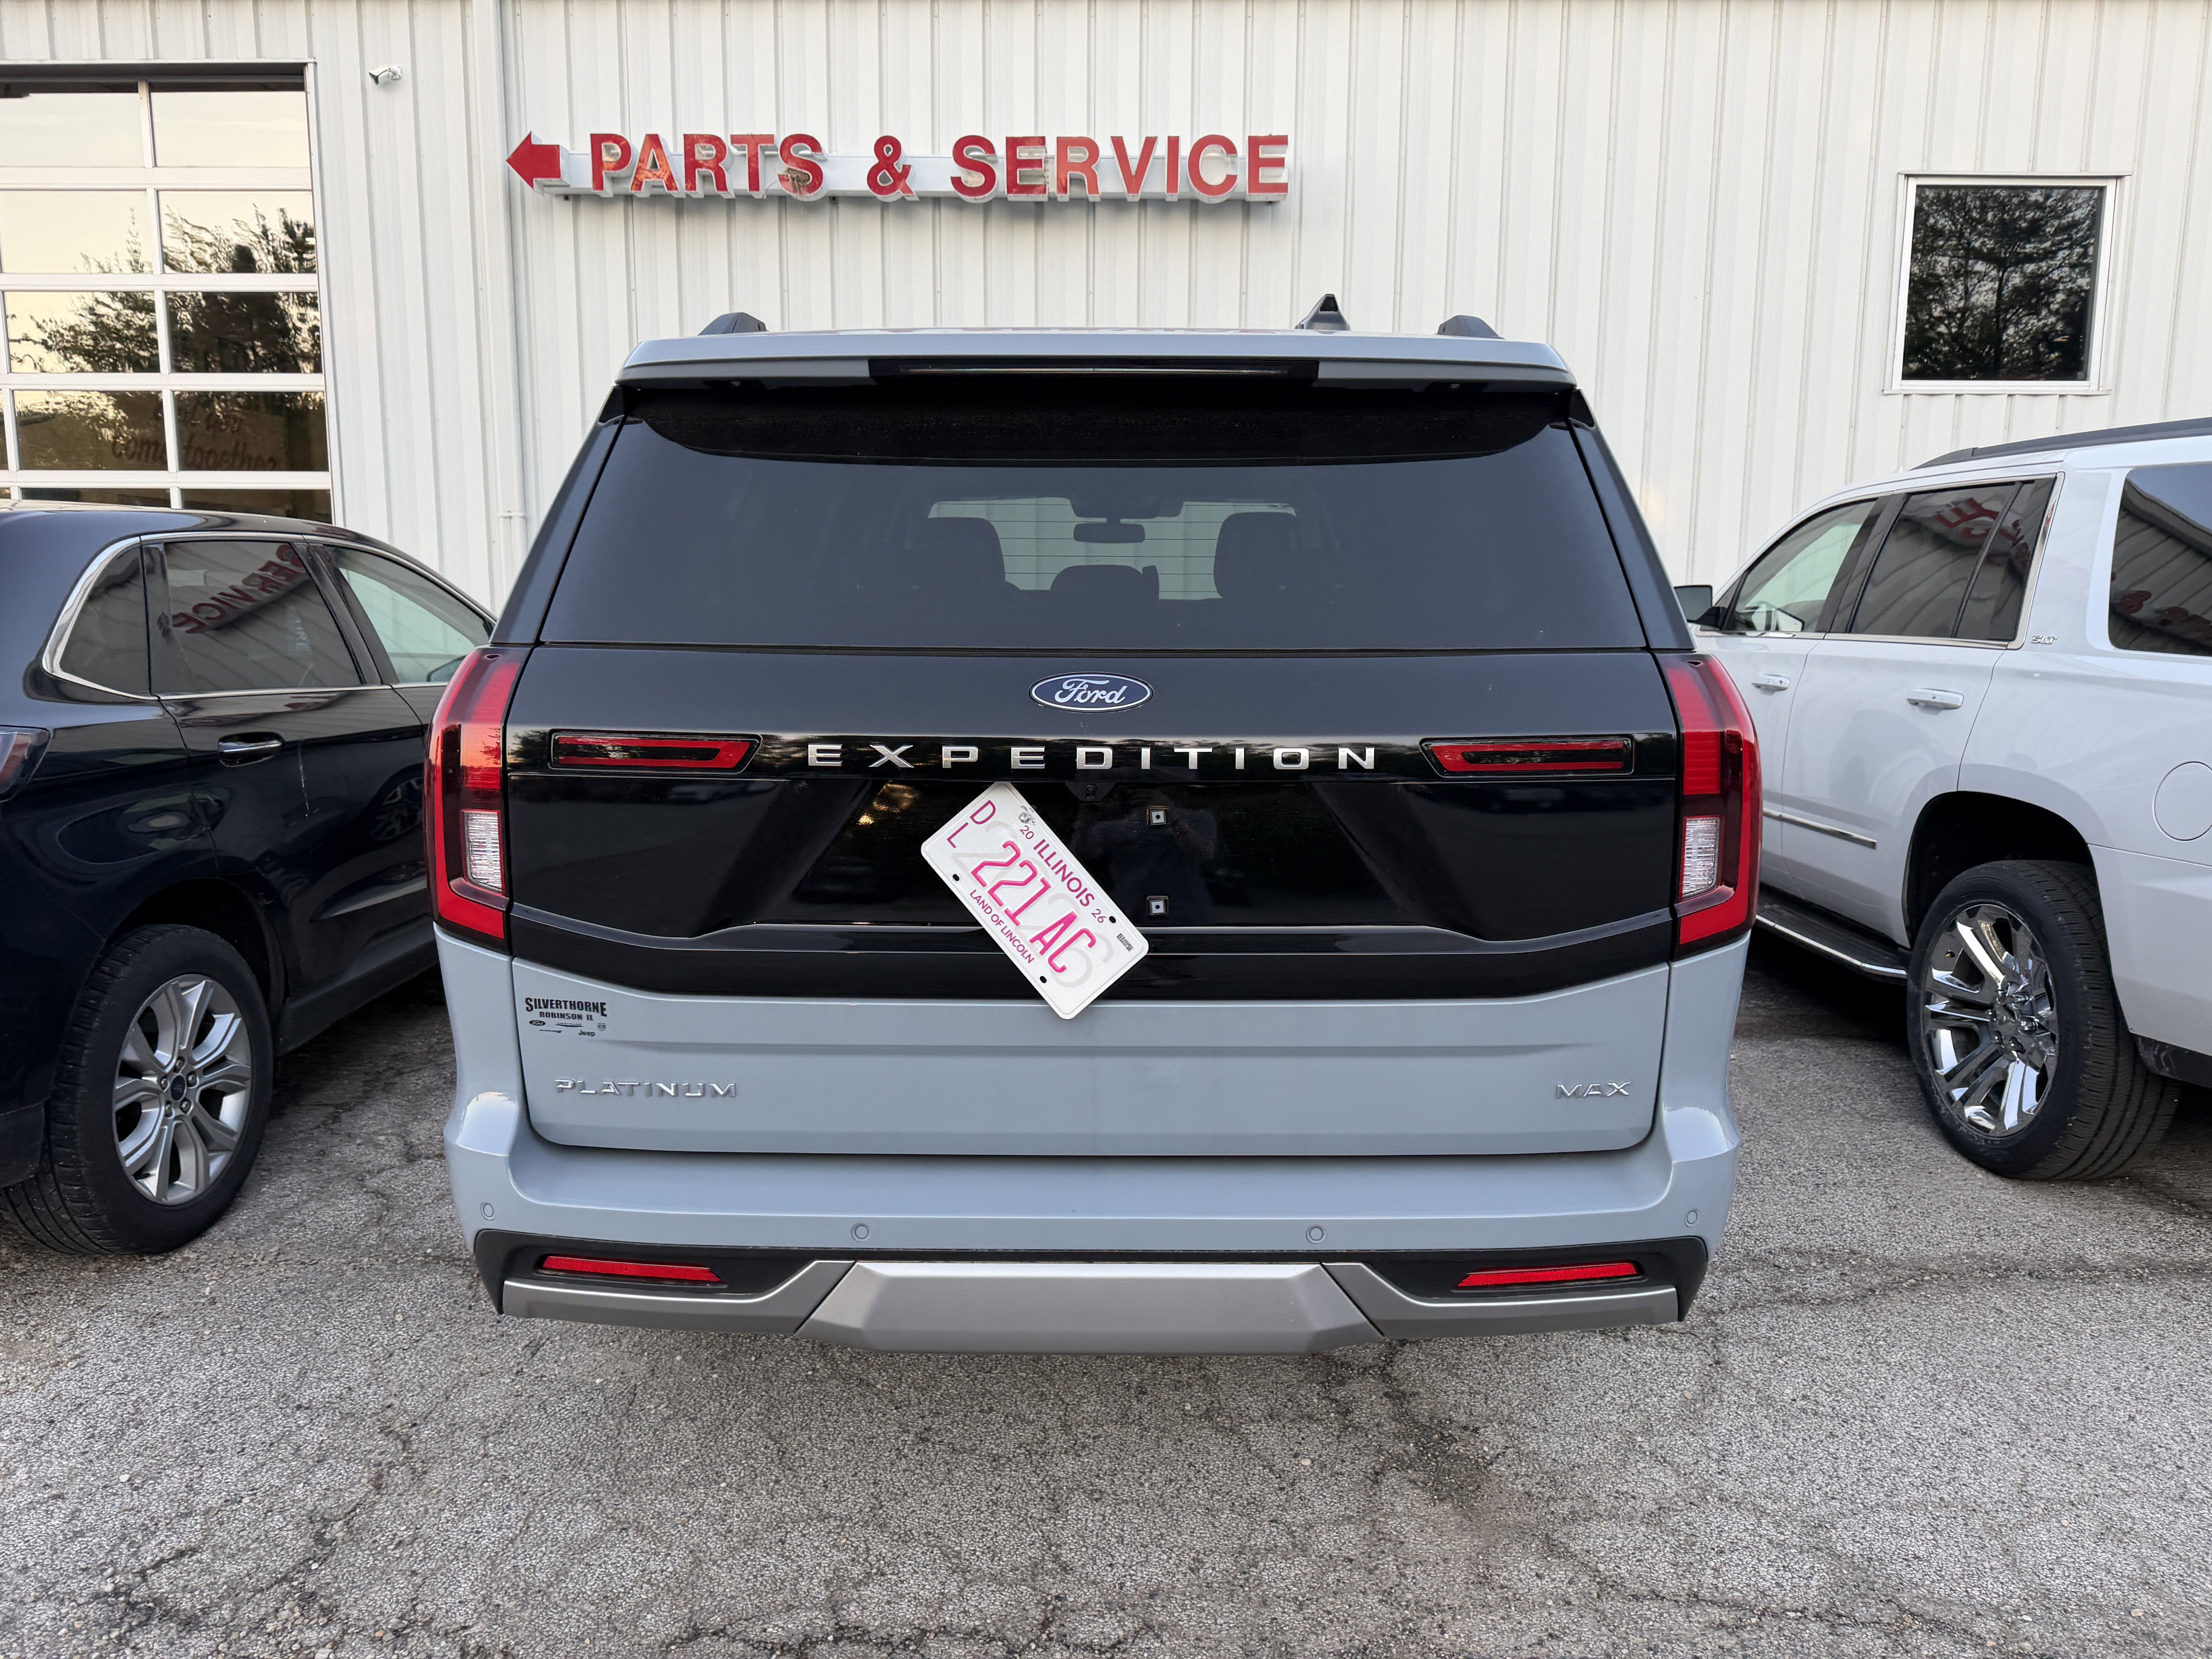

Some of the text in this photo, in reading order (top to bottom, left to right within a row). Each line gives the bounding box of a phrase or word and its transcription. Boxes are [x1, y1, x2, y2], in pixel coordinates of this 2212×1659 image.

[589, 133, 1290, 199] PARTS & SERVICE
[2030, 635, 2058, 644] SLT
[1054, 678, 1127, 704] Ford
[808, 744, 1375, 770] EXPEDITION
[970, 800, 996, 824] D
[946, 822, 969, 848] L
[1020, 825, 1107, 923] 20 ILLINOIS 26
[970, 841, 1096, 973] 221 AC
[970, 890, 1035, 963] LAND OF LINCOLN
[525, 998, 607, 1017] SILVERTHORNE
[539, 1012, 582, 1020] ROBINSON
[554, 1079, 736, 1097] PLATINUM
[1556, 1081, 1631, 1098] MAX
